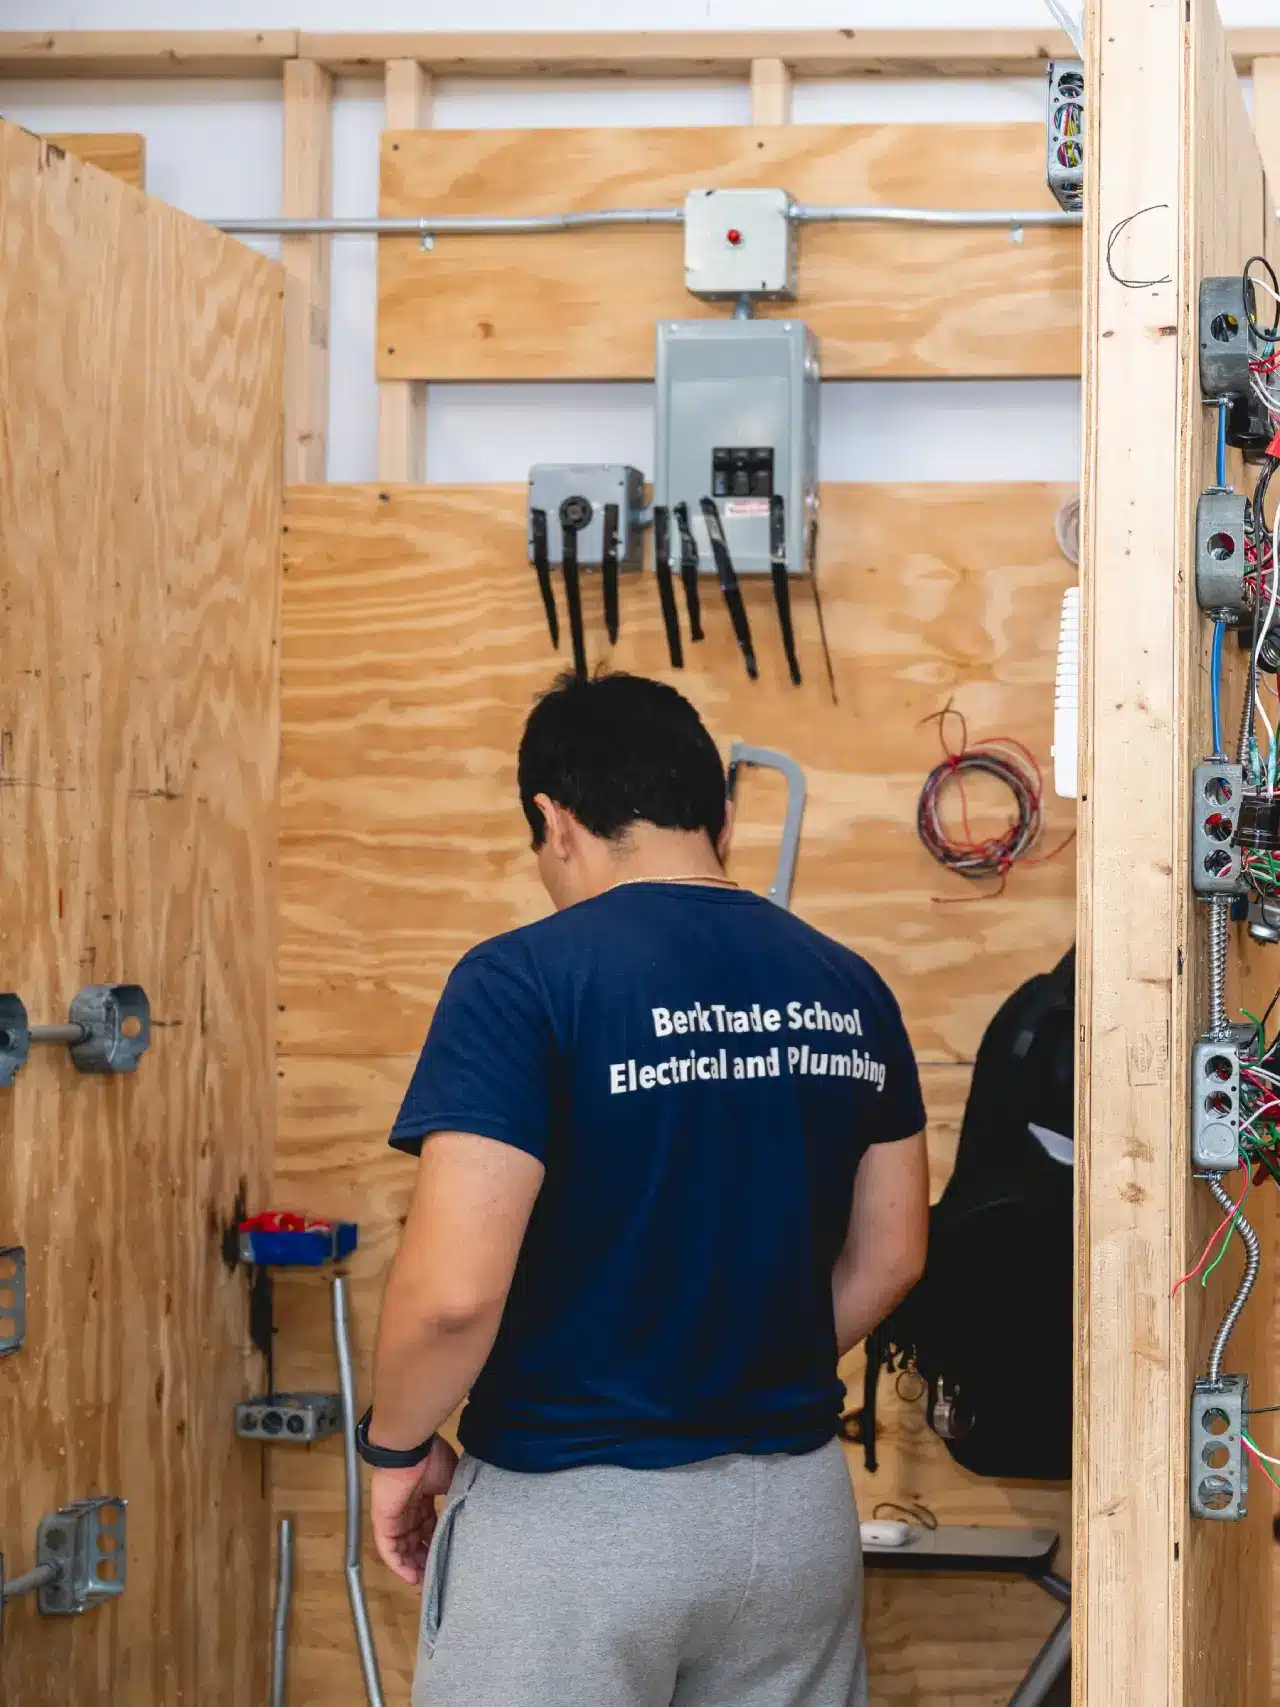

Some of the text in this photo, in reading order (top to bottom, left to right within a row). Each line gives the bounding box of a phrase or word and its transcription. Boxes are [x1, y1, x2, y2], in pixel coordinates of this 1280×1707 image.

[651, 1001, 863, 1038] Berk Trade School
[609, 1045, 887, 1095] Electrical and Plumbing
